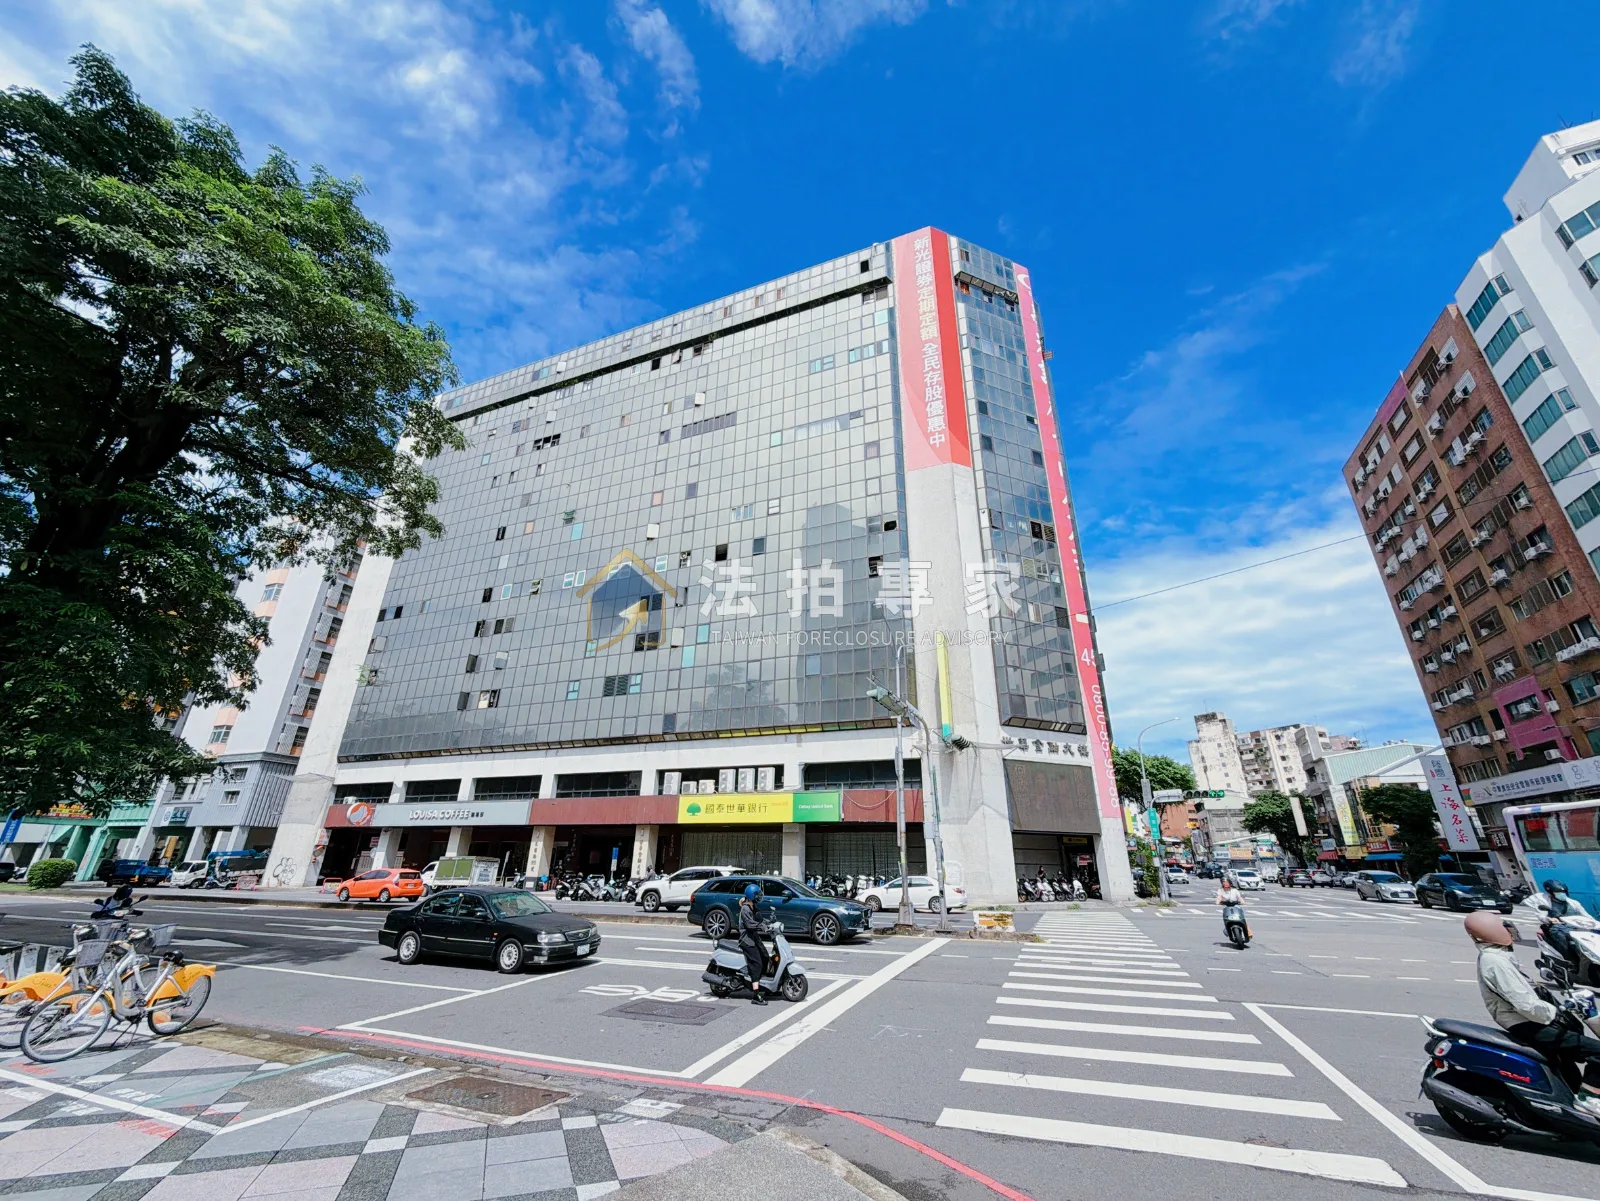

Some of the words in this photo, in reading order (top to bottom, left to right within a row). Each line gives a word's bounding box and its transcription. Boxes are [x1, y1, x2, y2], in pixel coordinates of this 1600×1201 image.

[913, 235, 938, 341] 新光證券定期定額
[921, 342, 946, 448] 全民存股優惠中
[409, 810, 438, 820] LOUISA
[440, 809, 470, 820] COFFEE
[705, 803, 767, 814] 國泰世華銀行
